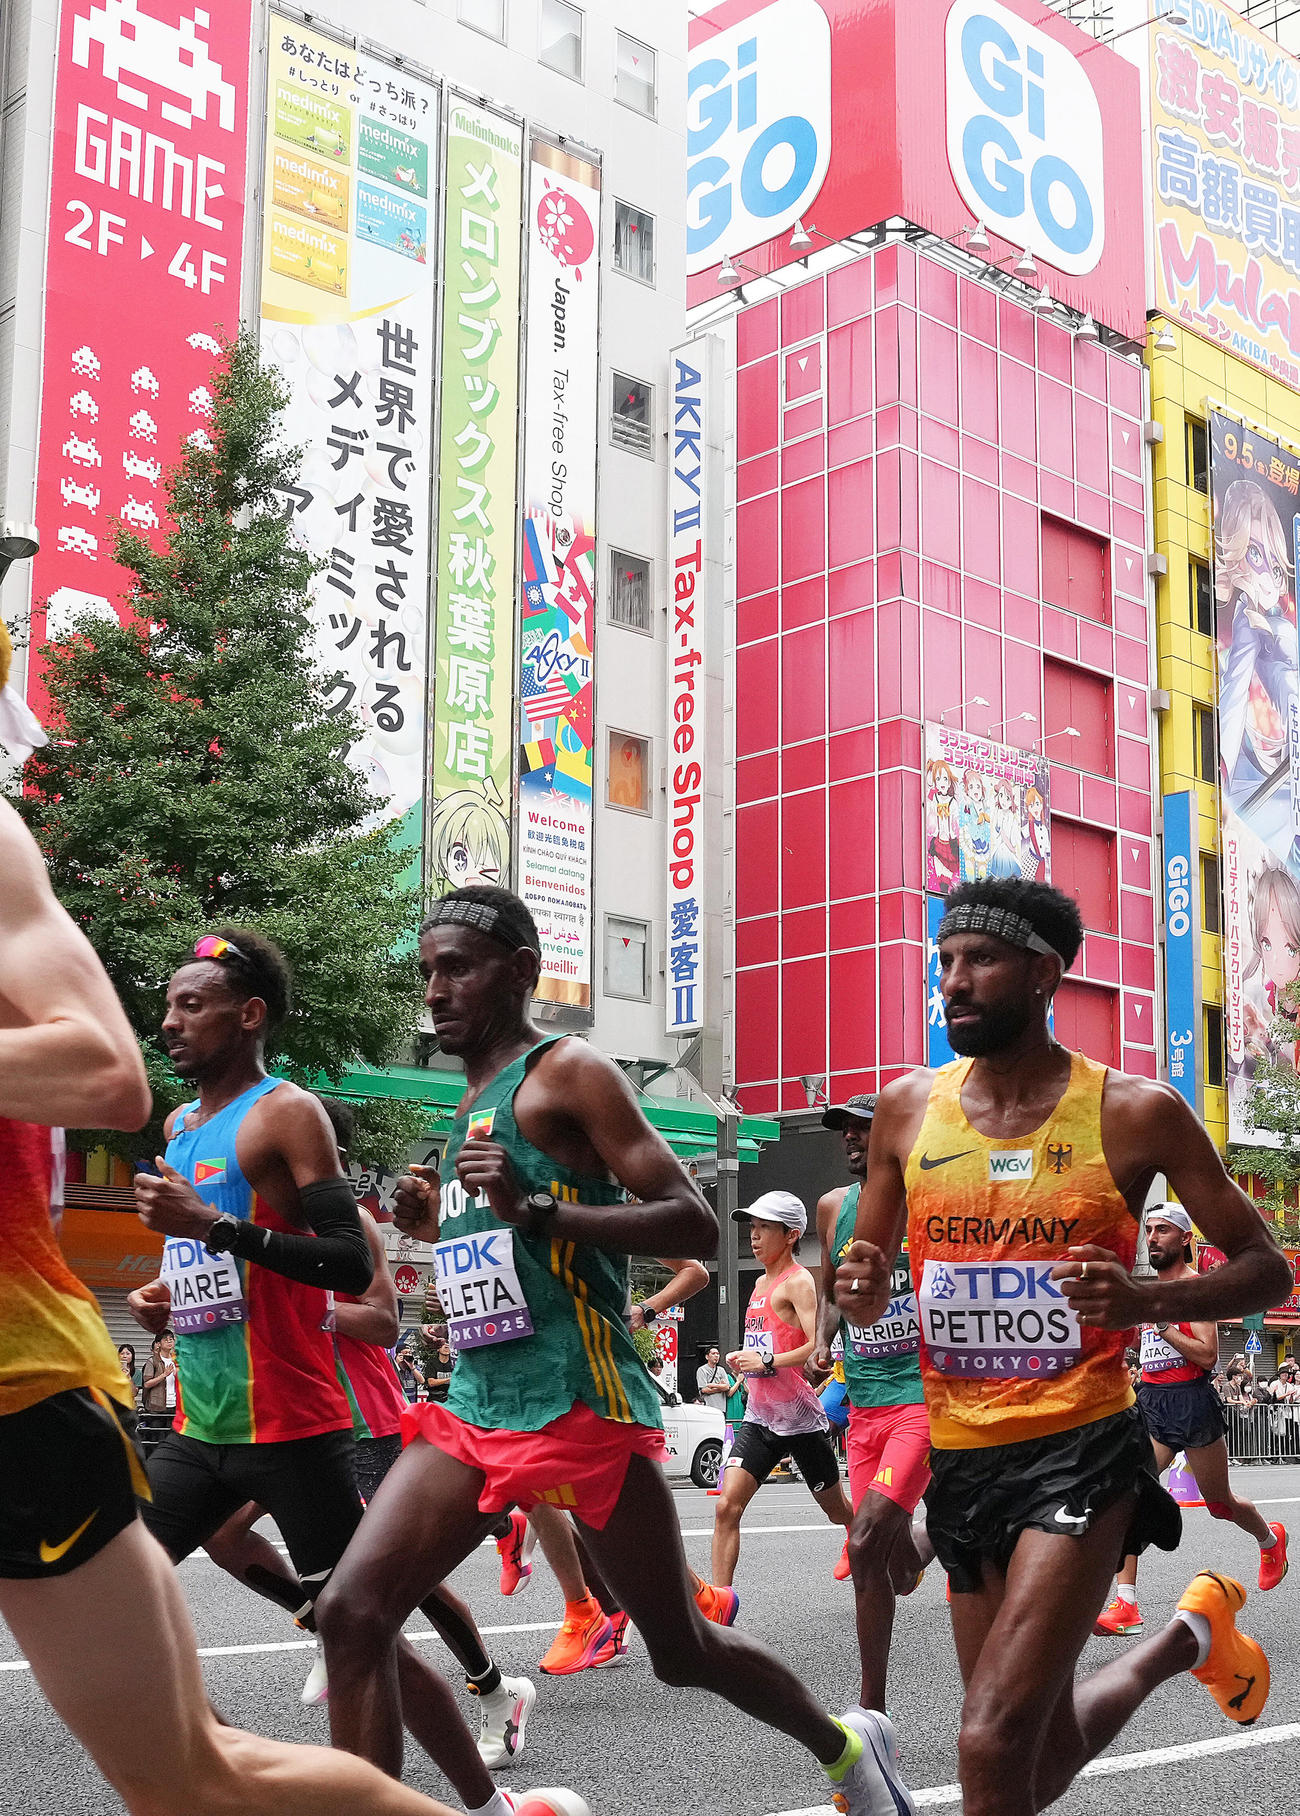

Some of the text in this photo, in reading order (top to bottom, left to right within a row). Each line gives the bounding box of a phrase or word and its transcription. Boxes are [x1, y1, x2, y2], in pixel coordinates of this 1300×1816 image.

[281, 35, 429, 114] あなたはどっち派？
[961, 14, 1045, 141] Gi
[278, 87, 340, 123] medimix
[360, 123, 418, 157] medimix
[455, 112, 520, 157] Melonbooks
[74, 102, 226, 231] GAME
[276, 155, 338, 190] medimix
[962, 114, 1094, 255] GO
[359, 188, 417, 222] medimix
[64, 200, 127, 256] 2F
[168, 242, 228, 295] 4F
[274, 222, 336, 255] medimix
[1179, 300, 1231, 340] ムーラン
[1232, 332, 1268, 365] AKIBA
[552, 369, 569, 454] Tax-free
[674, 358, 701, 497] AKKY
[445, 161, 501, 778] メロンブックス秋葉原店
[548, 461, 567, 517] Shop
[369, 319, 418, 733] 世界で愛される
[321, 371, 369, 761] メディミック
[673, 539, 702, 754] Tax-free
[528, 811, 585, 835] Welcome
[669, 761, 702, 889] Shop
[525, 875, 585, 896] Bienvenidos
[526, 860, 585, 881] Selamat datang
[525, 893, 587, 910] ДОБРО ПОЖАЛОВАТЬ
[1168, 855, 1190, 937] GiGO
[1170, 1029, 1193, 1078] 3号館
[989, 1158, 1031, 1172] WGV
[926, 1215, 1080, 1244] GERMANY
[436, 1235, 503, 1277] TDK
[954, 1267, 1069, 1299] TDK
[853, 1317, 920, 1340] DERIBA
[929, 1308, 1071, 1343] PETROS
